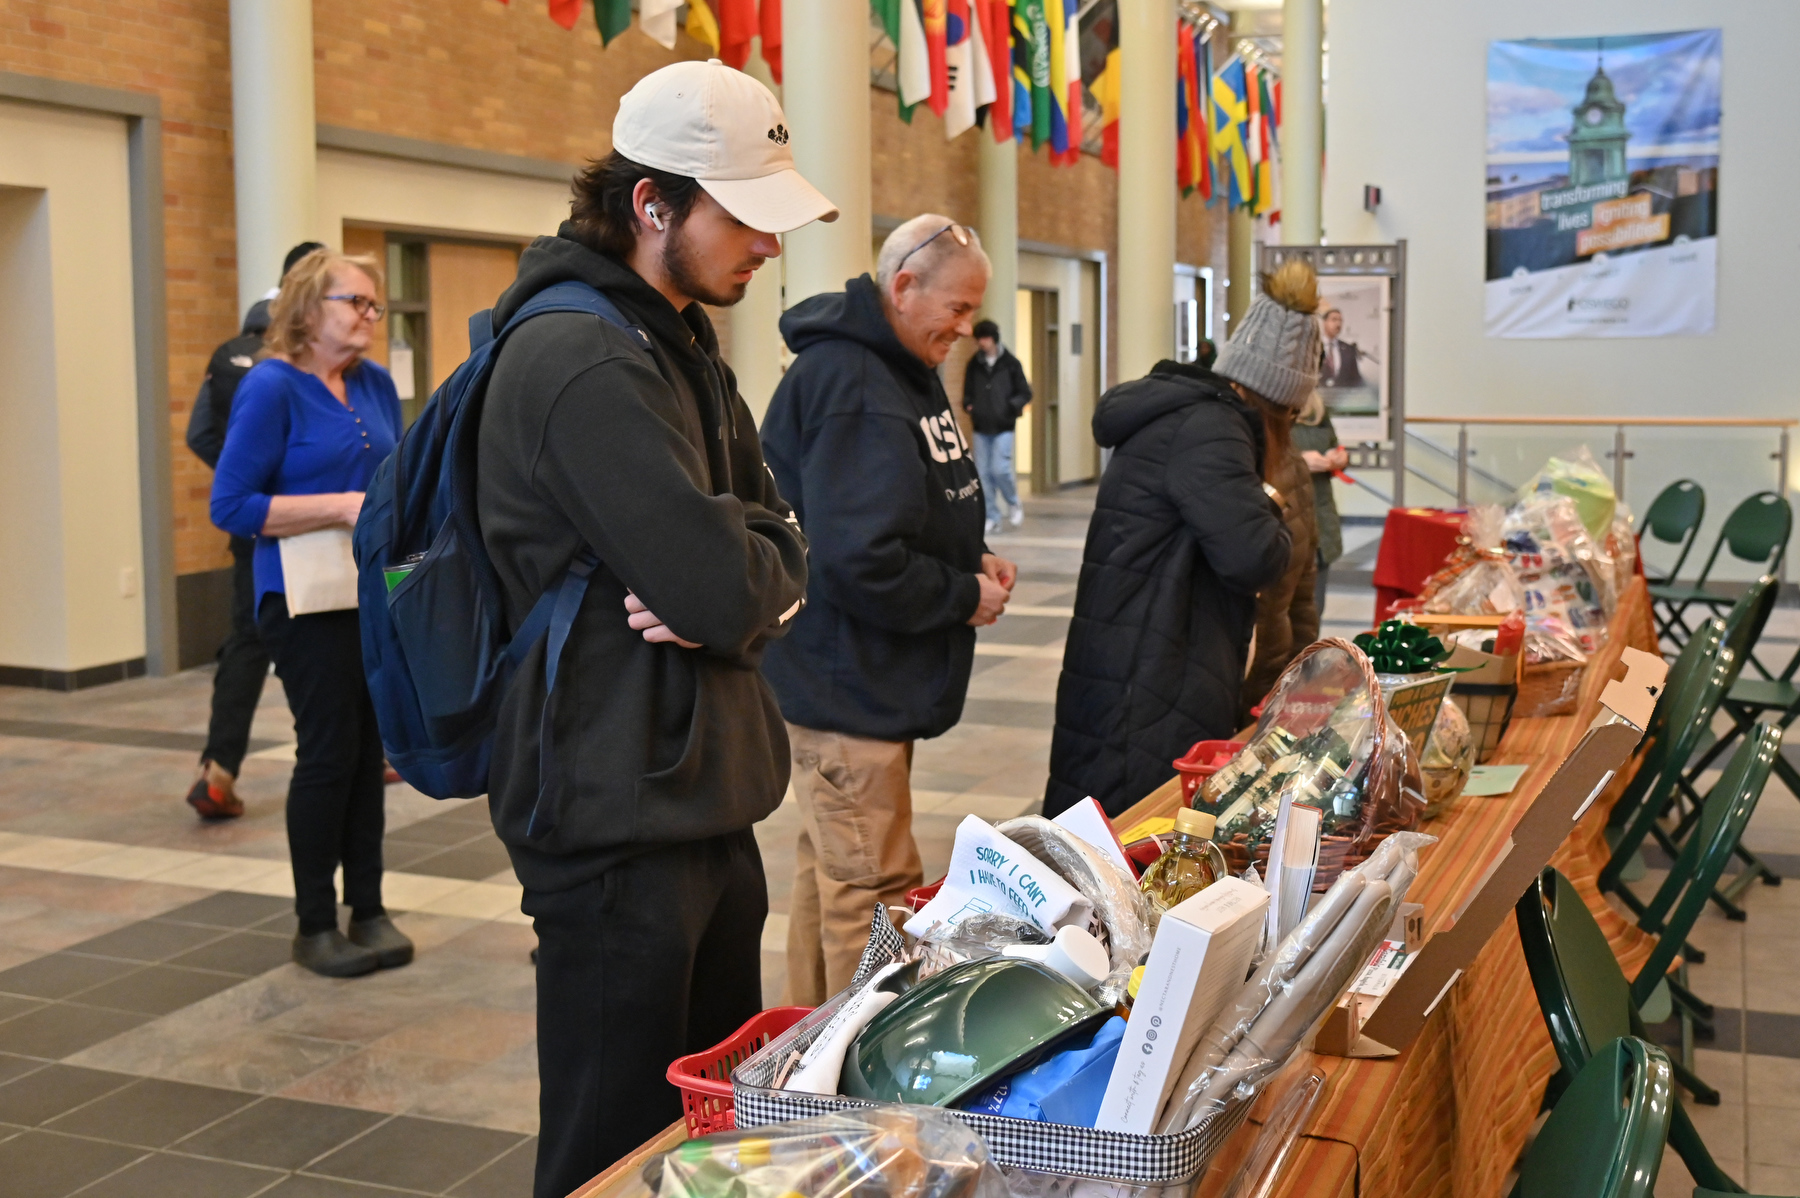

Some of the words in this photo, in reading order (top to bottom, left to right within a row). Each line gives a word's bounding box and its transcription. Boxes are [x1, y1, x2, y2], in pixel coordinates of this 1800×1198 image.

[1541, 180, 1629, 210] transforming
[1557, 210, 1589, 231] lives
[1596, 200, 1649, 226] igniting
[1581, 220, 1662, 254] possibilities
[970, 870, 976, 884] I
[978, 869, 997, 888] HAVE
[996, 877, 1006, 895] TO
[976, 846, 1009, 869] SORRY
[1009, 864, 1019, 876] I
[1019, 874, 1046, 908] CANT
[987, 1084, 1008, 1113] 12.7%
